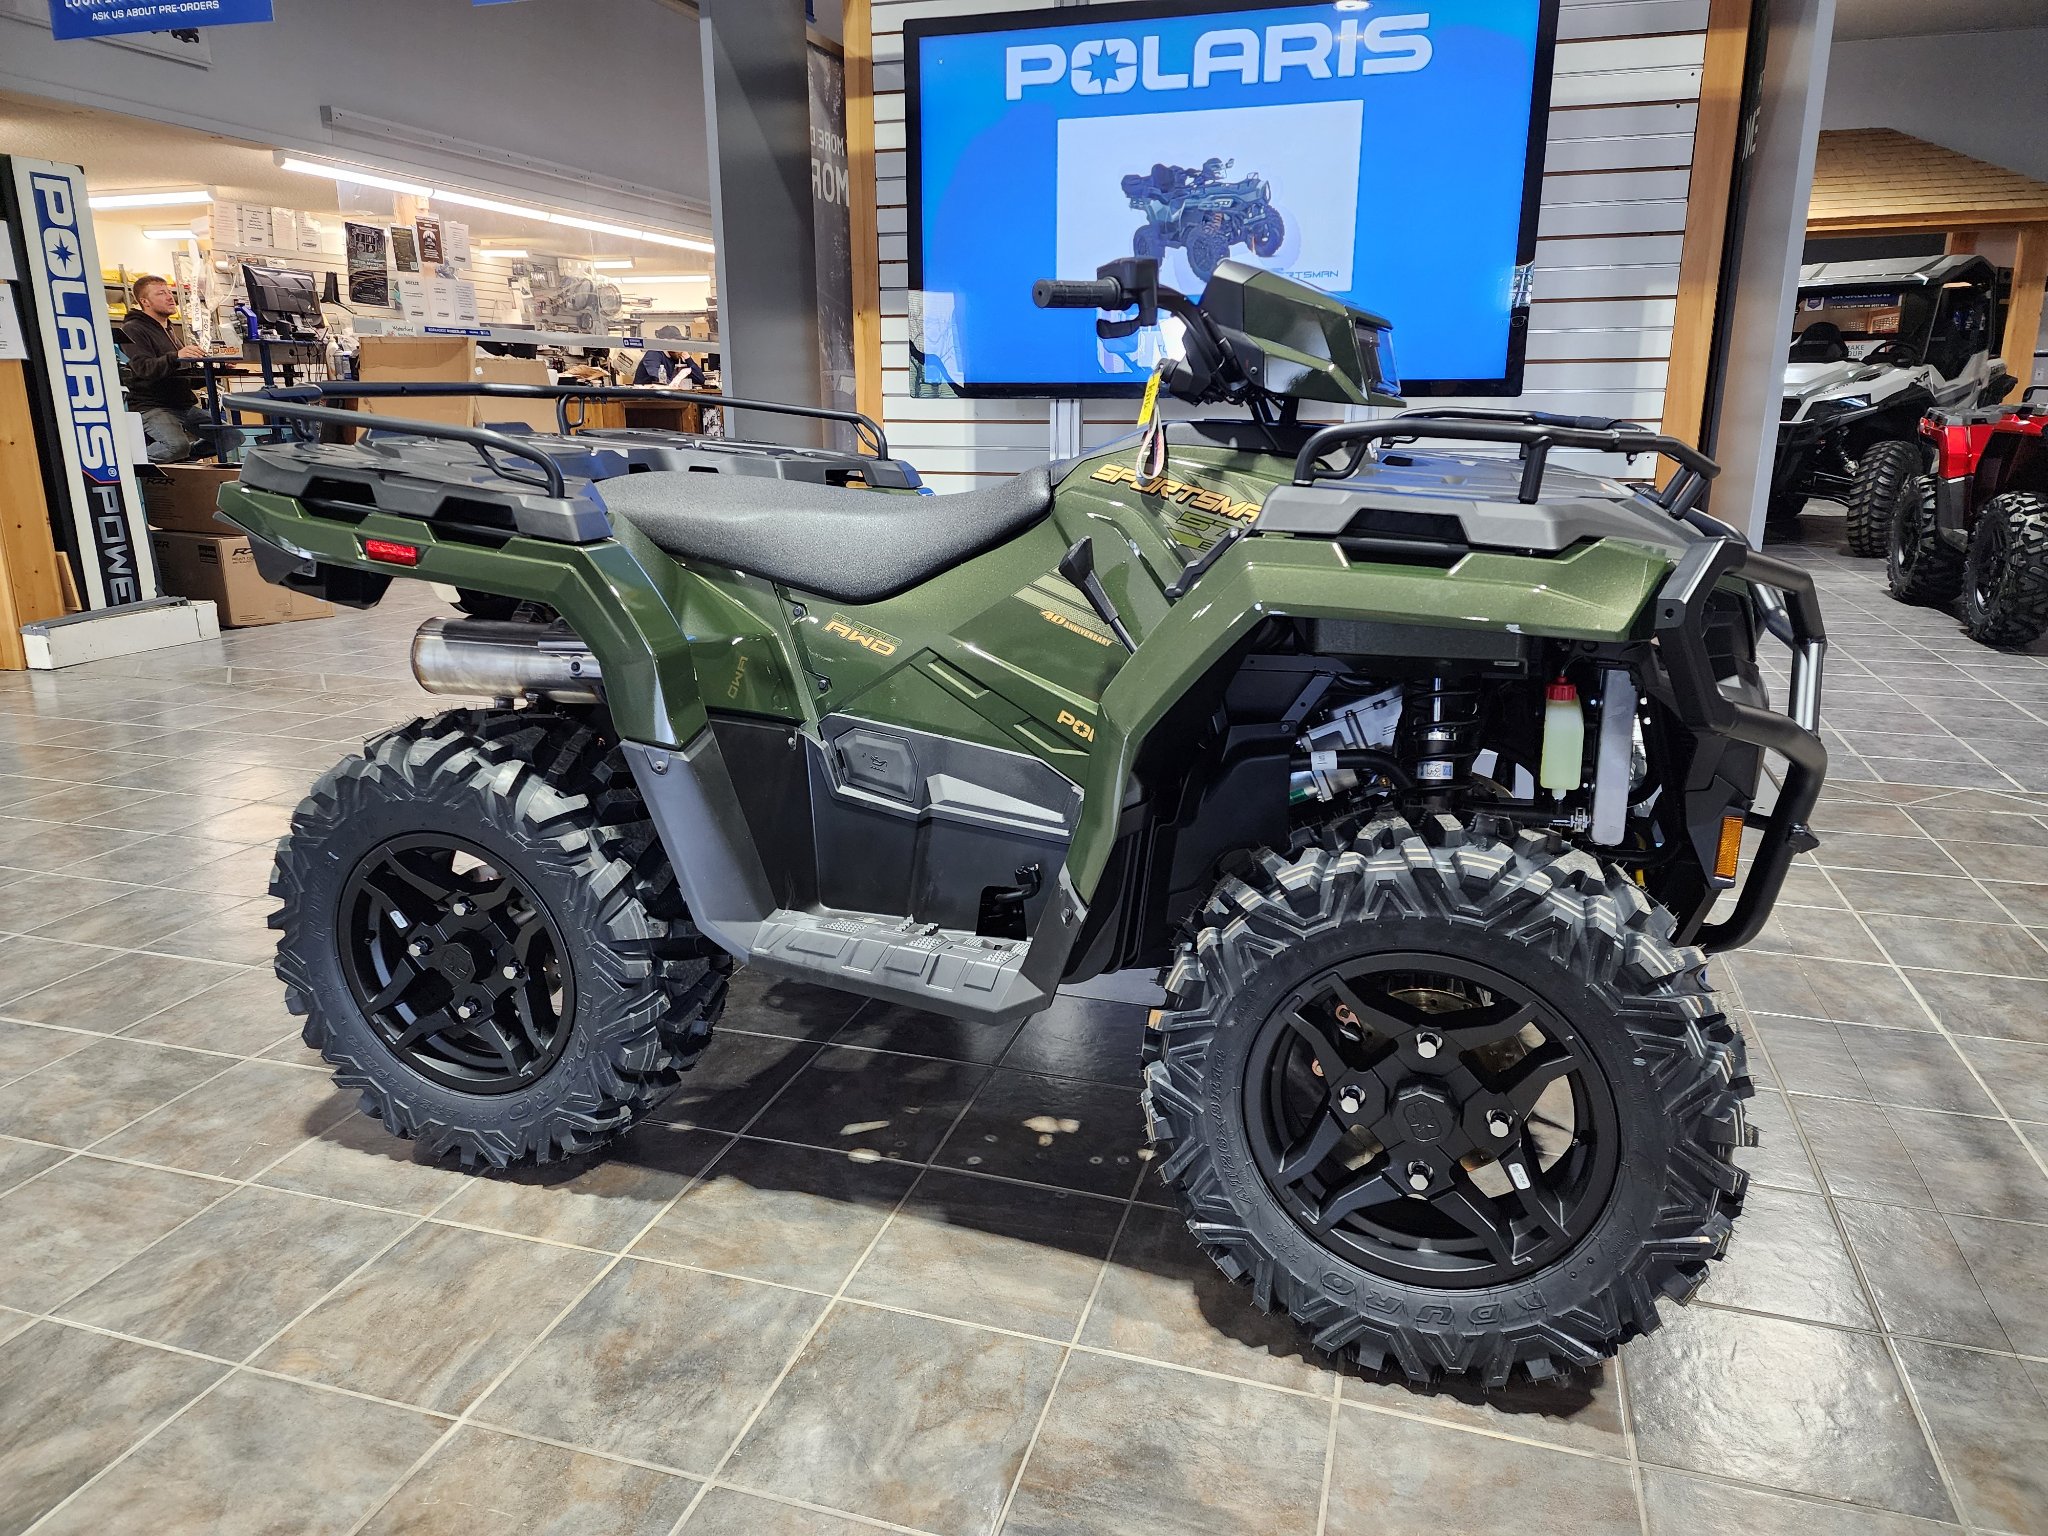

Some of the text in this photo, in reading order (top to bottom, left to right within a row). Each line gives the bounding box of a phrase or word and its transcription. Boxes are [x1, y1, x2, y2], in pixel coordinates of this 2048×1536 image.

[92, 0, 220, 22] ASK US ABOUT PRE-ORDERS
[1005, 13, 1434, 101] POLARIS
[33, 176, 116, 471] POLARIS
[822, 619, 898, 656] AWD
[1040, 610, 1113, 647] 40 ANNIVERSARY
